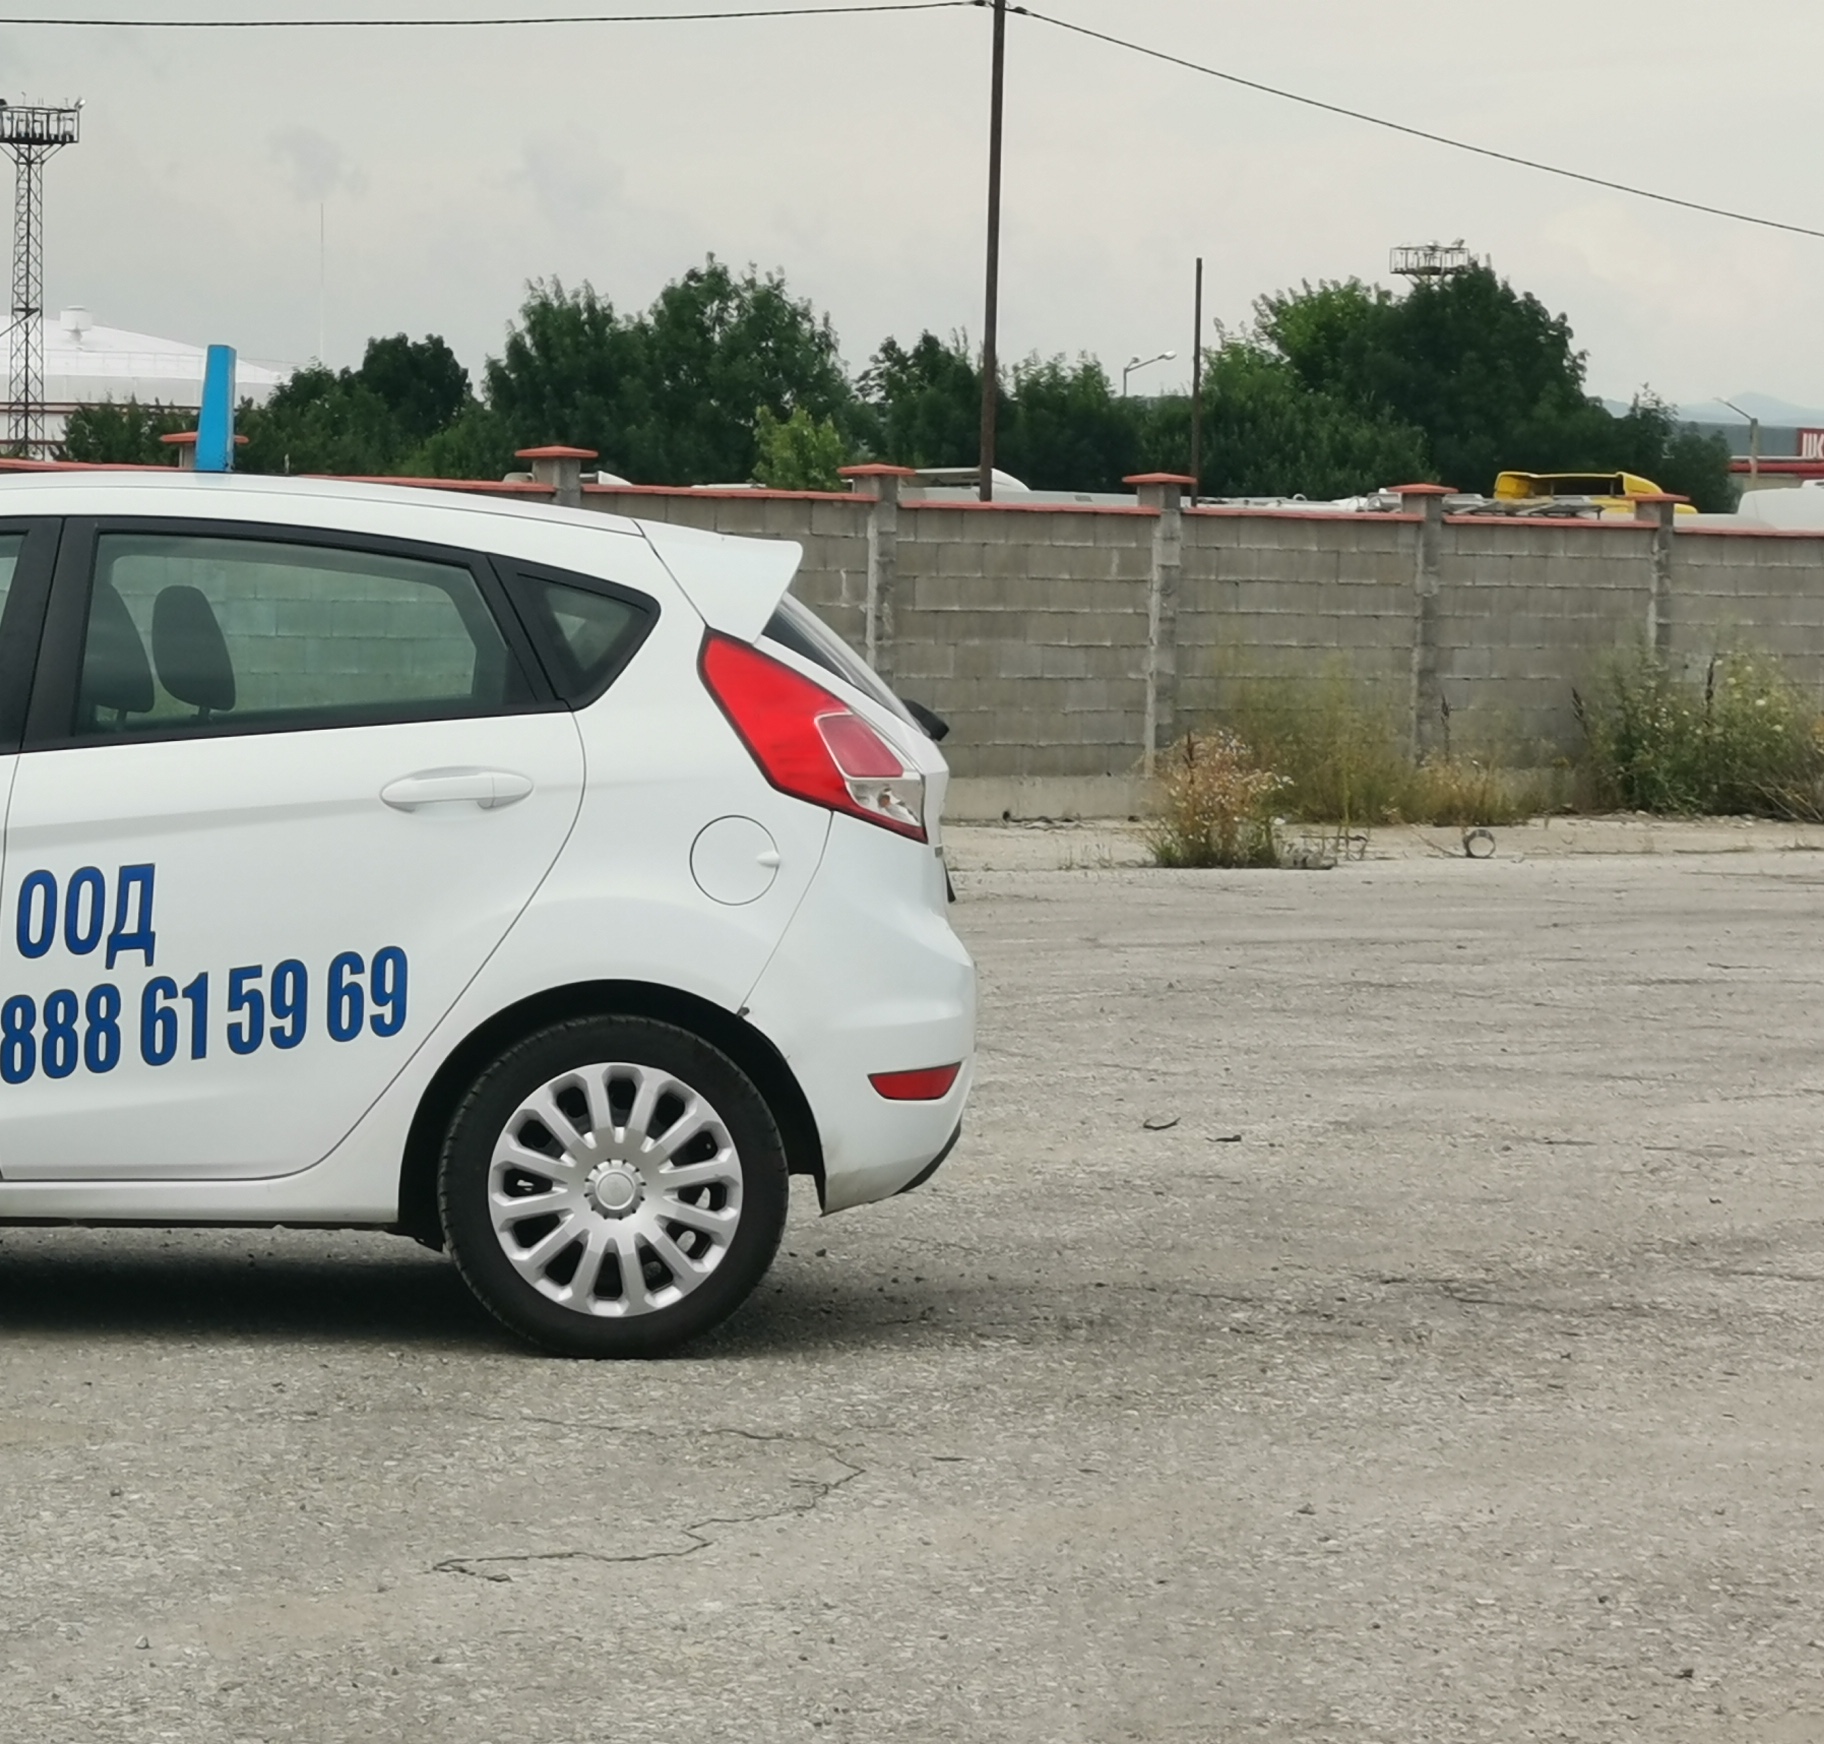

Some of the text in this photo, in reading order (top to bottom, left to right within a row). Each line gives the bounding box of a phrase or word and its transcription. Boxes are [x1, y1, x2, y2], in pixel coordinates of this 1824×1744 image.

[17, 863, 155, 970] ООД
[140, 972, 208, 1066] 61
[227, 959, 308, 1055] 59
[327, 946, 407, 1042] 69
